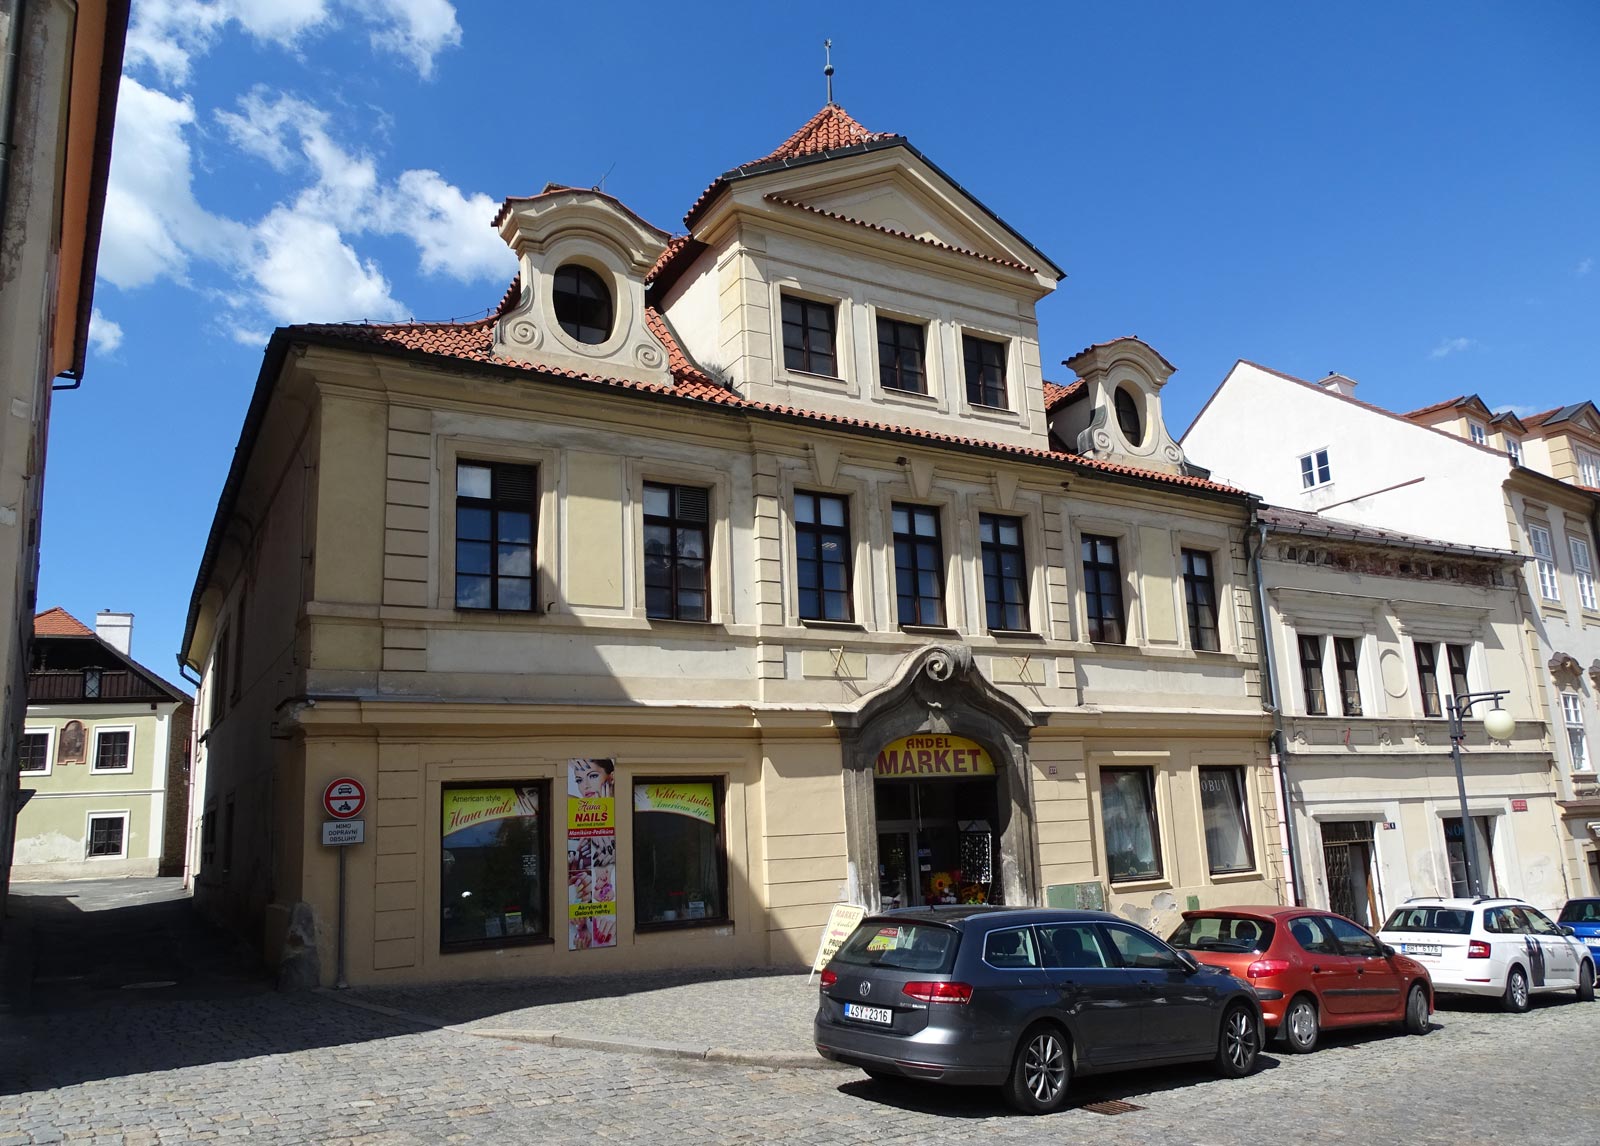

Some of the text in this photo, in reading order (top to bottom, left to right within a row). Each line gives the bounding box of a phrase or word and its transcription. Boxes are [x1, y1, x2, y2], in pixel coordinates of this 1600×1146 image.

[877, 749, 981, 775] MARKET
[486, 794, 502, 803] style
[449, 807, 482, 829] Hana
[575, 812, 608, 822] NAILS
[835, 909, 860, 920] MARKET
[850, 1008, 888, 1022] 4SY 2316
